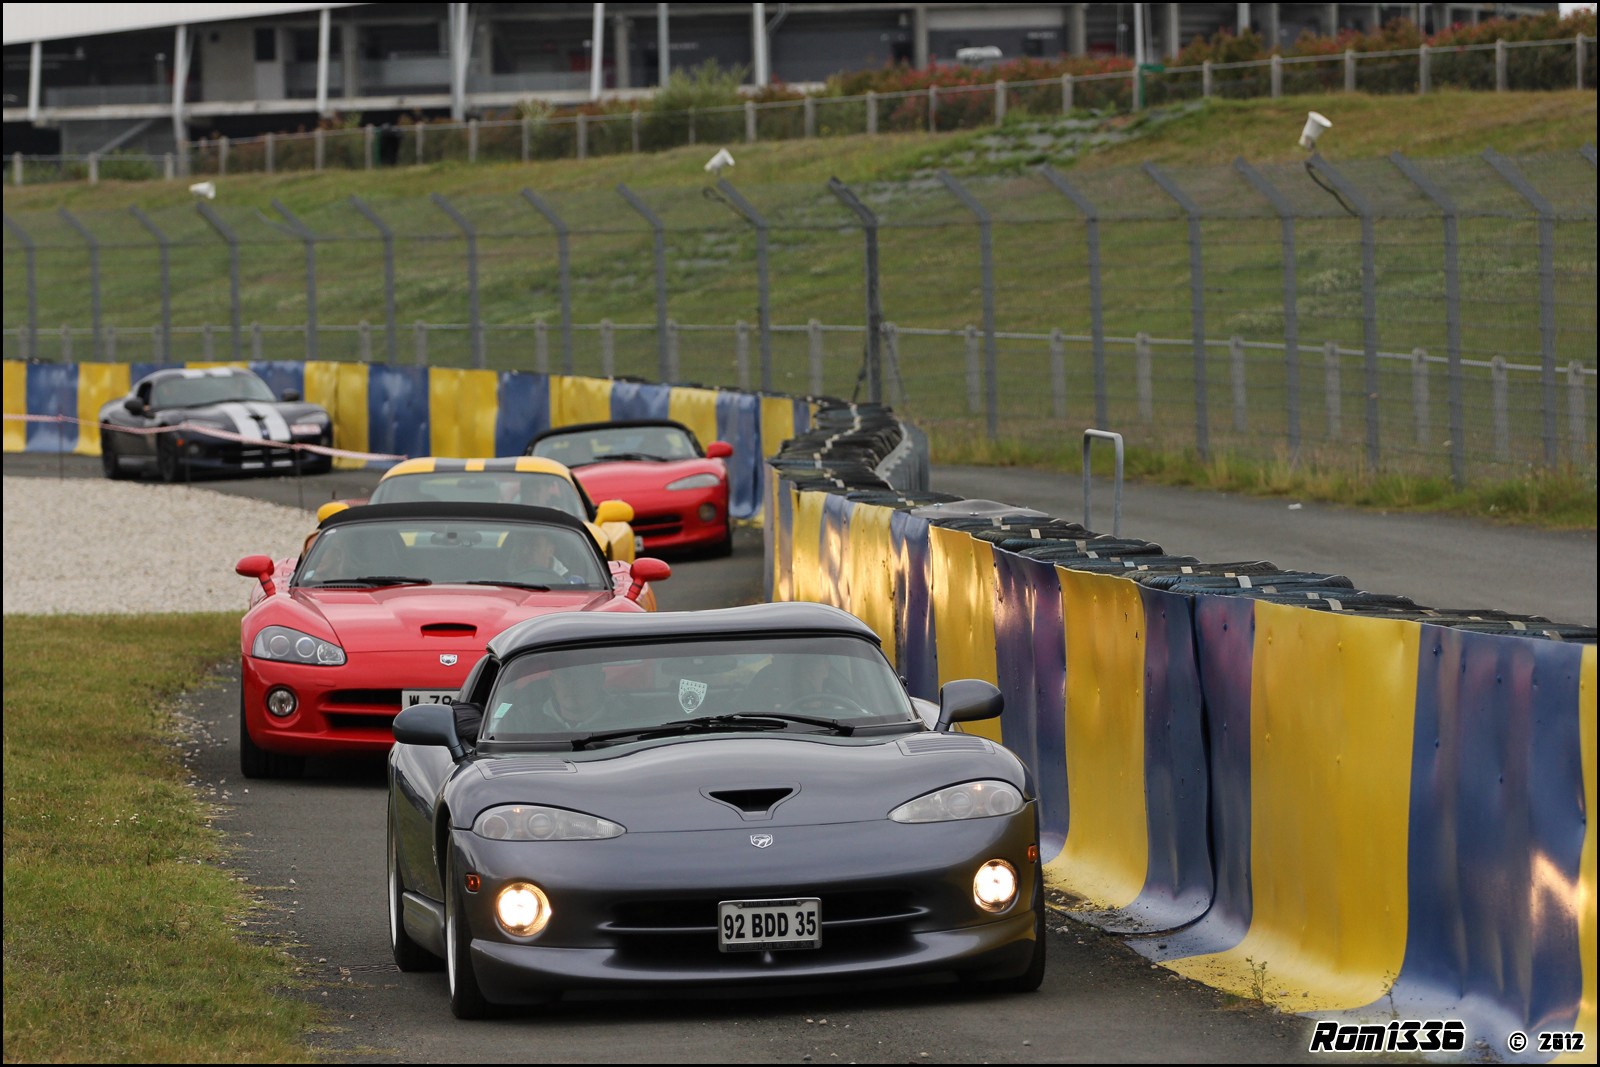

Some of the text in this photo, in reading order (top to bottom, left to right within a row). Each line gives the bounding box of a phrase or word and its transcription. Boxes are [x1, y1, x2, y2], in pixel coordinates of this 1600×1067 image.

[724, 911, 816, 939] 92 BDD 35
